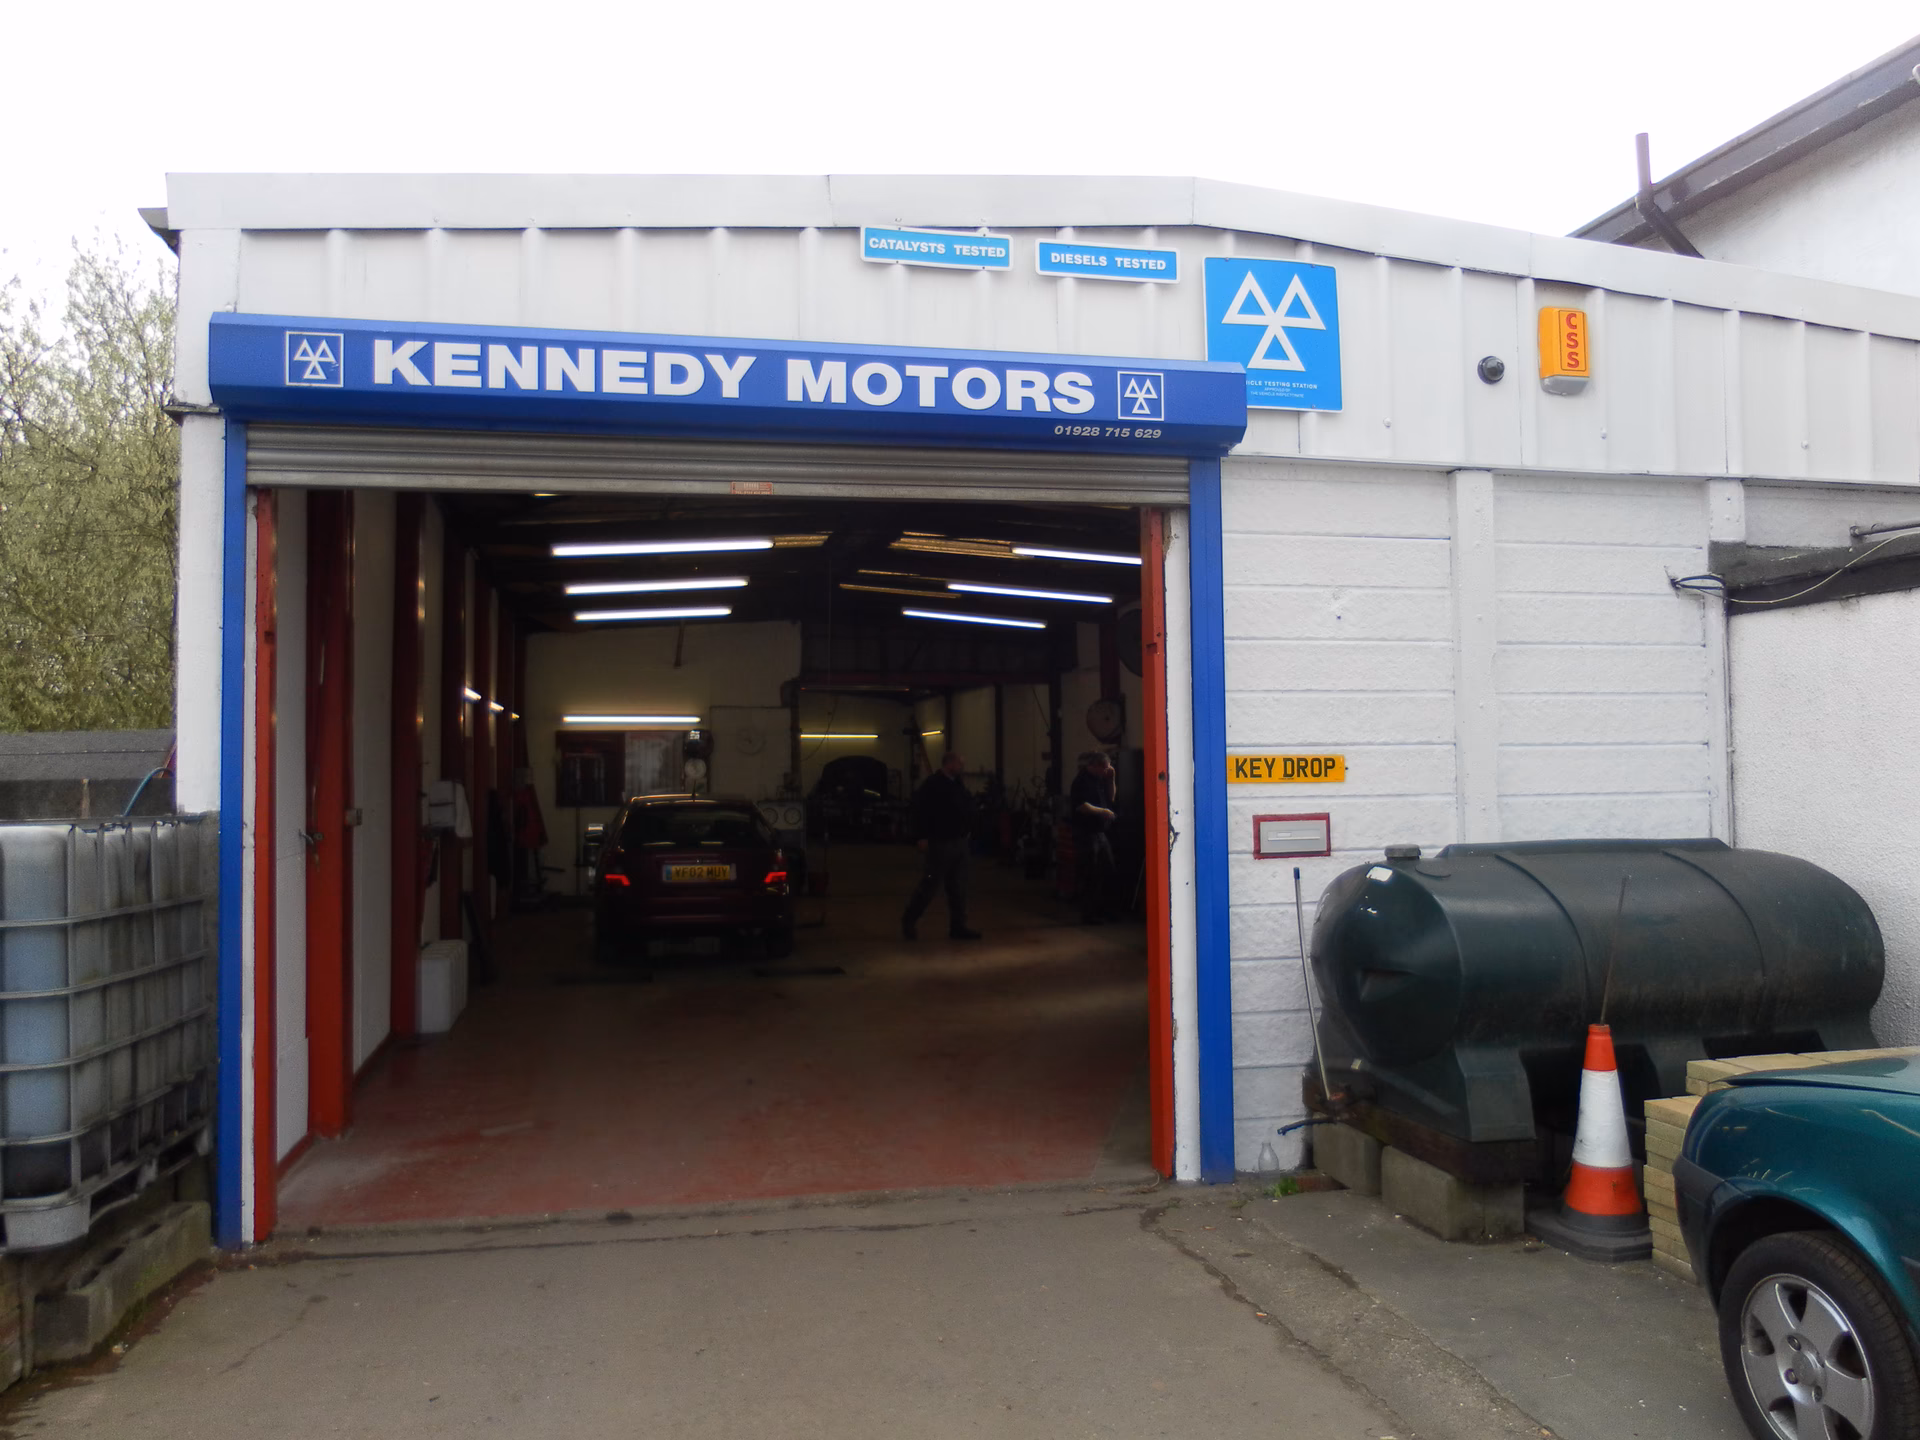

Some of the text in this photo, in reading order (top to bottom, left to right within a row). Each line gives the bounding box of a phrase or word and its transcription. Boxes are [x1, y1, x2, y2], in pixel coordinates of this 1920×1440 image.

[869, 238, 1006, 258] CATALYSTS TESTED
[1051, 252, 1167, 271] DIESELS TESTED
[1565, 312, 1580, 369] CSS
[373, 338, 1096, 415] KENNEDY MOTORS
[1054, 425, 1162, 439] 01928 715 629
[1235, 757, 1336, 779] KEY DROP
